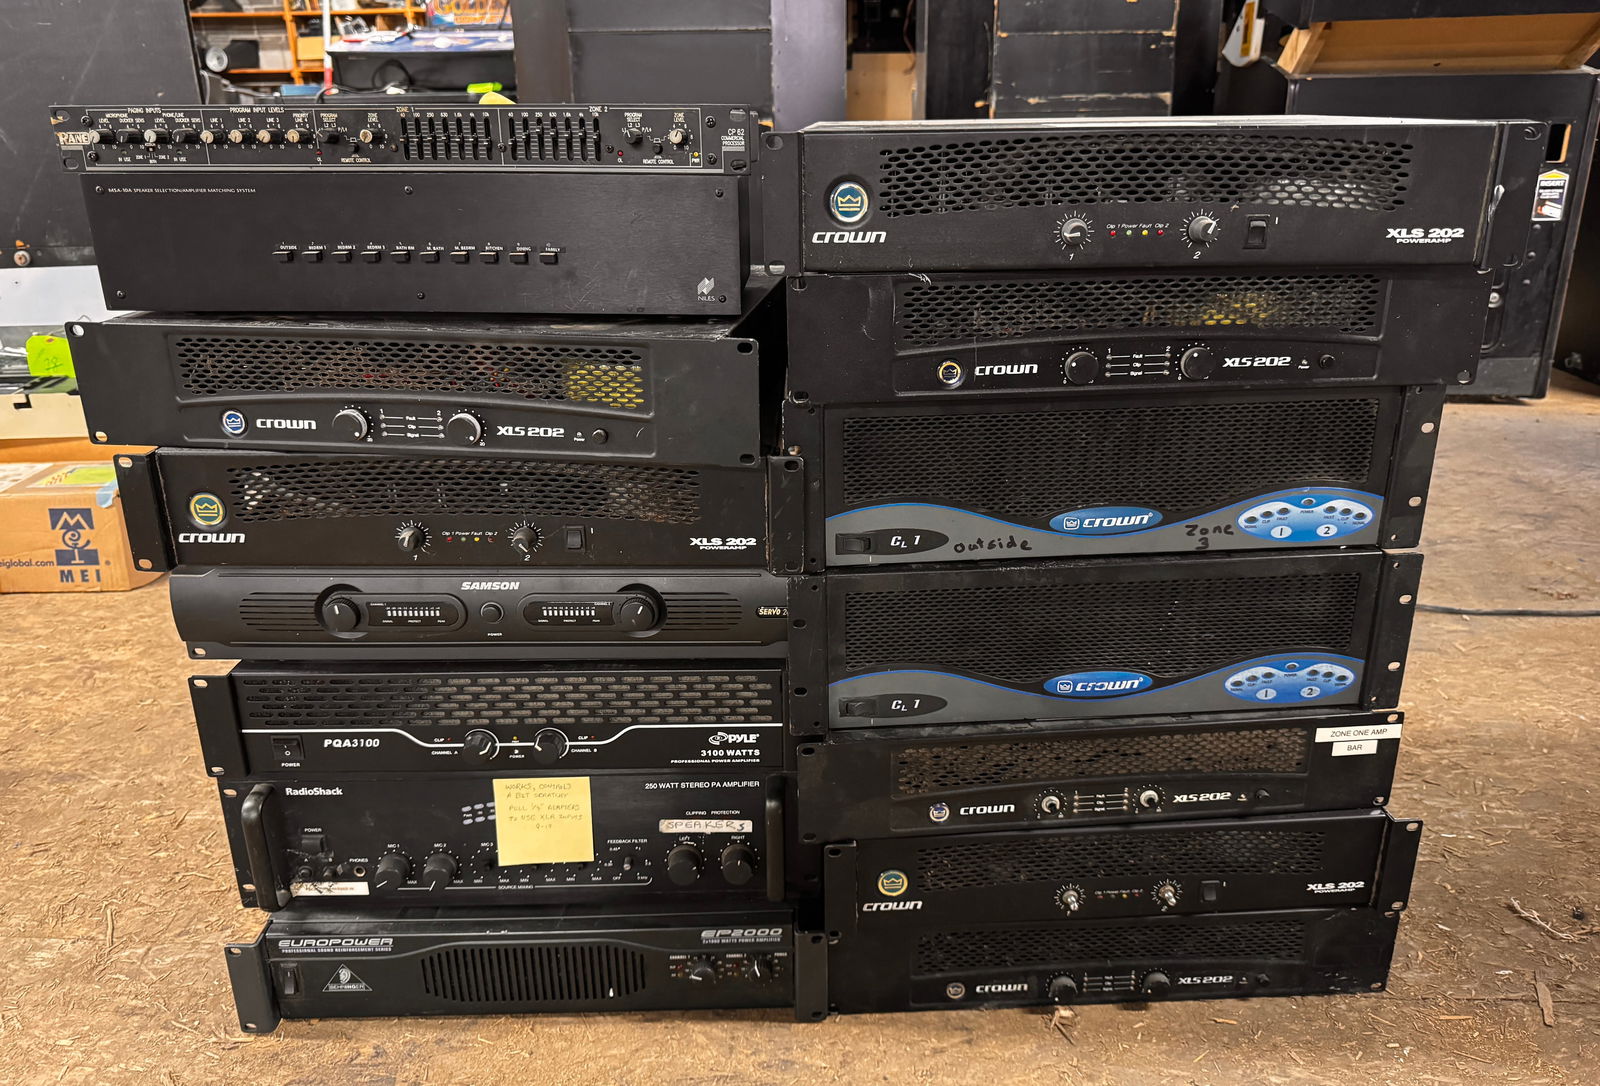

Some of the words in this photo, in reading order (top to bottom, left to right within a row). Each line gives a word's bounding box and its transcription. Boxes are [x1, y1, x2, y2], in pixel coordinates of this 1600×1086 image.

[60, 132, 89, 144] RANE
[1386, 228, 1424, 238] XLS
[1428, 228, 1464, 238] 202
[1193, 251, 1201, 259] 2
[1222, 358, 1252, 368] XLS
[1253, 357, 1291, 366] 202
[496, 426, 525, 436] XLS
[527, 427, 565, 438] 202
[914, 535, 920, 545] 1
[1195, 537, 1210, 550] 3
[60, 569, 102, 583] MEI
[461, 582, 520, 590] SAMSON
[324, 739, 380, 748] PQA3100
[728, 734, 756, 743] PYLE
[285, 788, 343, 796] RadioShack
[1173, 794, 1198, 802] XLS
[1199, 792, 1232, 801] 202
[701, 928, 782, 937] EP2000
[278, 938, 394, 947] EUROPOWER
